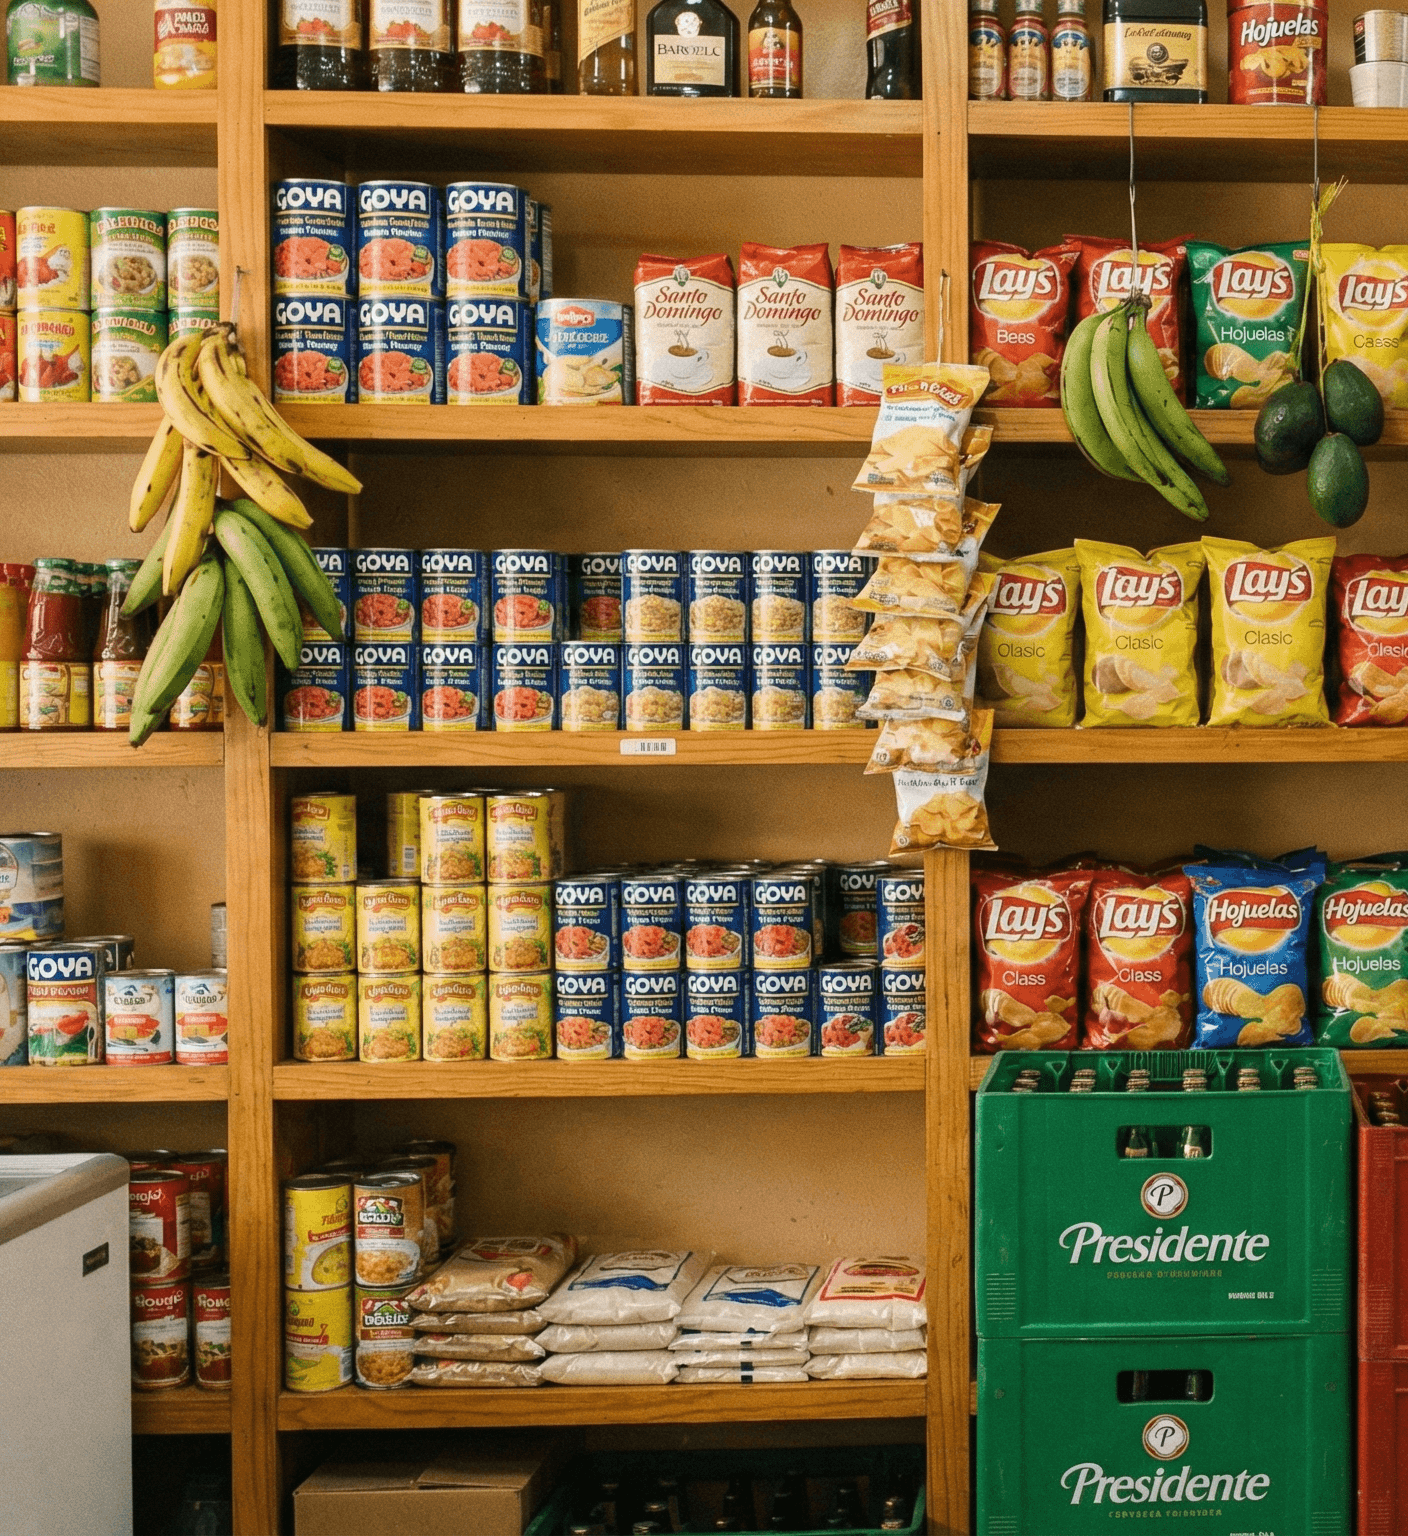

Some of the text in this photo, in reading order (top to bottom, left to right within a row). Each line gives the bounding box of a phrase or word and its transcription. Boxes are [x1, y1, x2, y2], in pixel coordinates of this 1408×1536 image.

[1240, 13, 1320, 48] Hojuelas
[276, 187, 342, 210] GOYA
[361, 188, 426, 211] GOYA
[449, 189, 514, 212] GOYA
[979, 263, 1054, 300] Lay's
[1218, 262, 1289, 299] Lay's
[655, 286, 708, 305] Santo
[755, 286, 807, 306] Santo
[854, 288, 906, 308] Santo
[1342, 275, 1408, 311] Lay's
[276, 302, 341, 324] GOYA
[360, 302, 425, 325] GOYA
[449, 303, 514, 326] GOYA
[643, 301, 722, 326] Domingo
[744, 301, 822, 327] Domingo
[842, 303, 920, 327] Domingo
[1221, 327, 1285, 345] Hojuelas
[356, 554, 410, 573] GOYA
[422, 554, 473, 573] GOYA
[495, 555, 549, 573] GOYA
[691, 557, 741, 575] GOYA
[1101, 566, 1179, 608] Lay's
[1229, 562, 1306, 602] Lay's
[1114, 635, 1164, 651] Clasic
[1244, 630, 1294, 646] Clasic
[300, 647, 342, 664] OYA
[355, 647, 407, 666] GOYA
[423, 647, 474, 666] GOYA
[496, 647, 549, 666] GOYA
[563, 647, 615, 667] GOYA
[627, 647, 680, 667] GOYA
[691, 647, 742, 667] GOYA
[753, 647, 802, 666] GOYA
[555, 886, 604, 904] GOYA
[623, 885, 675, 904] GOYA
[687, 885, 736, 904] GOYA
[755, 885, 806, 904] GOYA
[986, 899, 1066, 941] Lay's
[1100, 897, 1179, 940] Lay's
[1209, 899, 1298, 928] Hojuelas
[28, 957, 93, 981] GOYA
[1002, 970, 1046, 986] Class
[1118, 969, 1162, 984] Class
[1220, 960, 1288, 978] Hojuelas
[557, 976, 606, 994] GOYA
[625, 976, 676, 995] GOYA
[687, 975, 737, 994] GOYA
[755, 975, 806, 994] GOYA
[821, 975, 872, 993] GOYA
[1058, 1221, 1270, 1264] Presidente
[1060, 1462, 1271, 1505] Presidente
